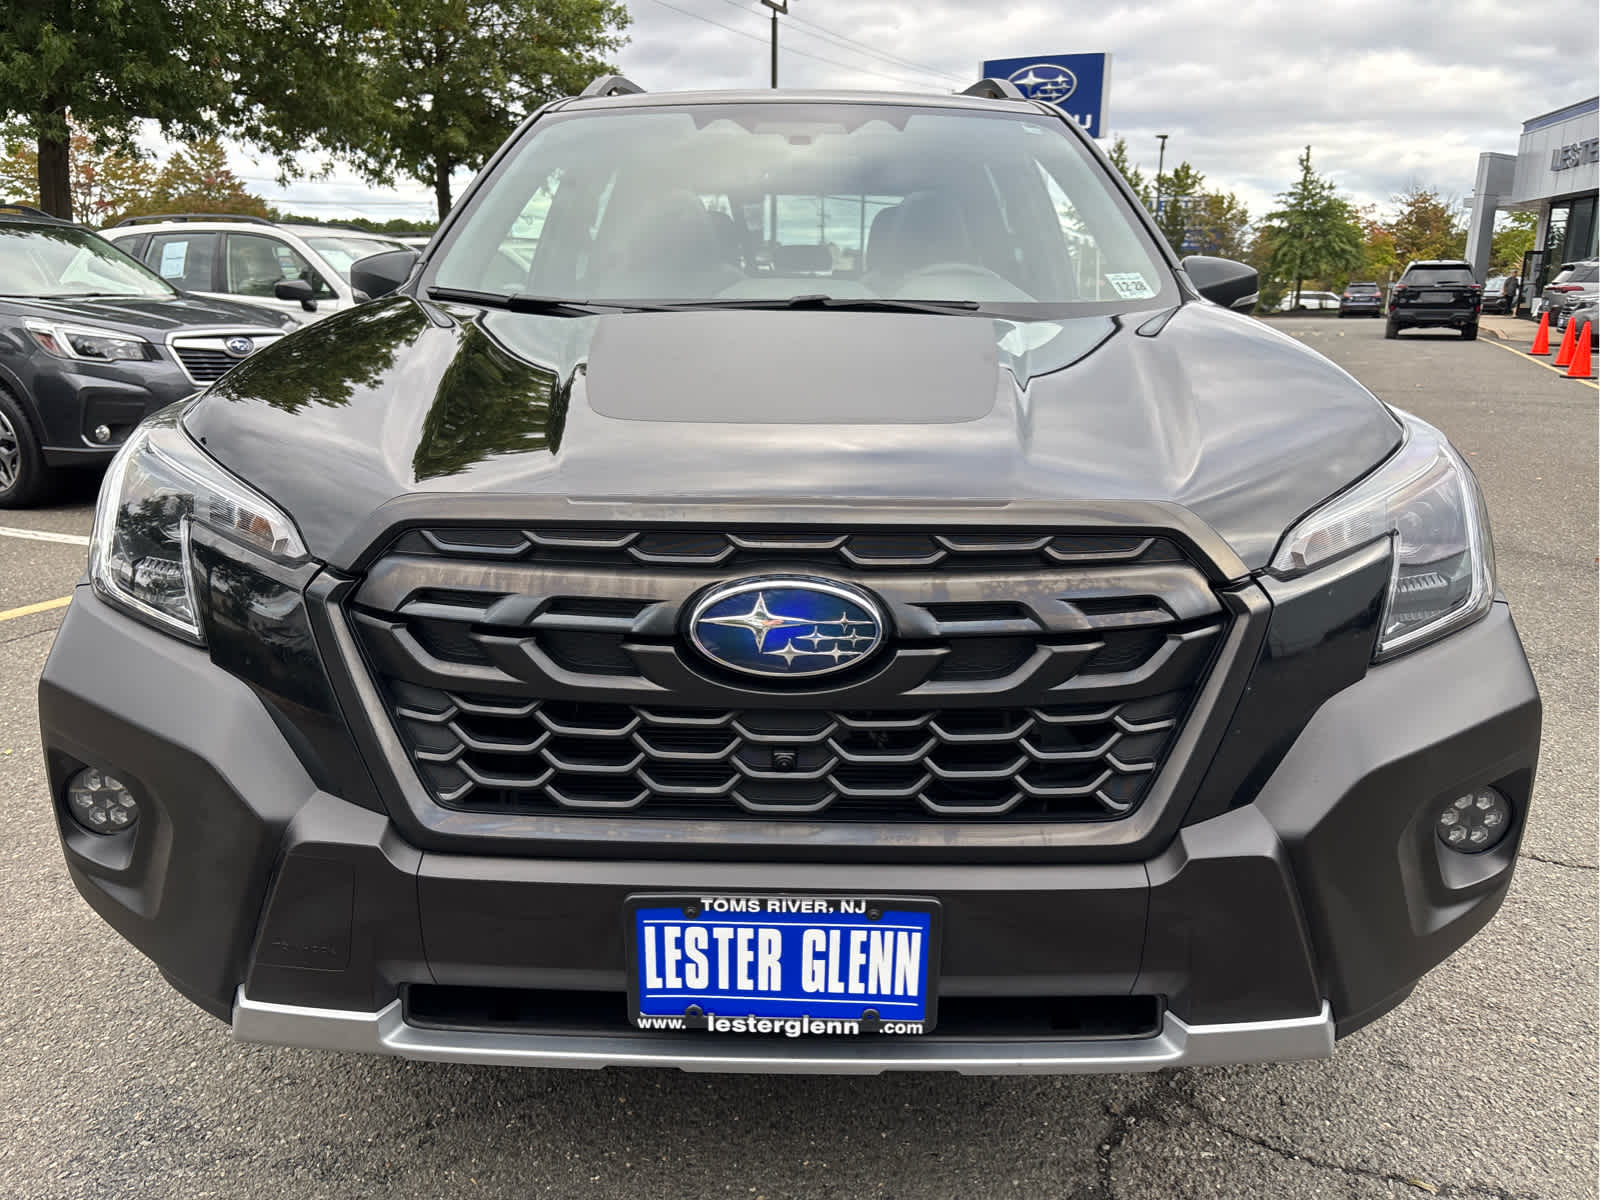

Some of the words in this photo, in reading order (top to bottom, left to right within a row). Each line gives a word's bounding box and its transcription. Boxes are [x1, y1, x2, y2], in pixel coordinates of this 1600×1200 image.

[700, 898, 761, 913] TOMS
[767, 899, 834, 915] RIVER,
[840, 899, 867, 914] NJ
[643, 925, 783, 992] LESTER
[801, 928, 923, 997] GLENN
[707, 1012, 860, 1037] lesterglenn
